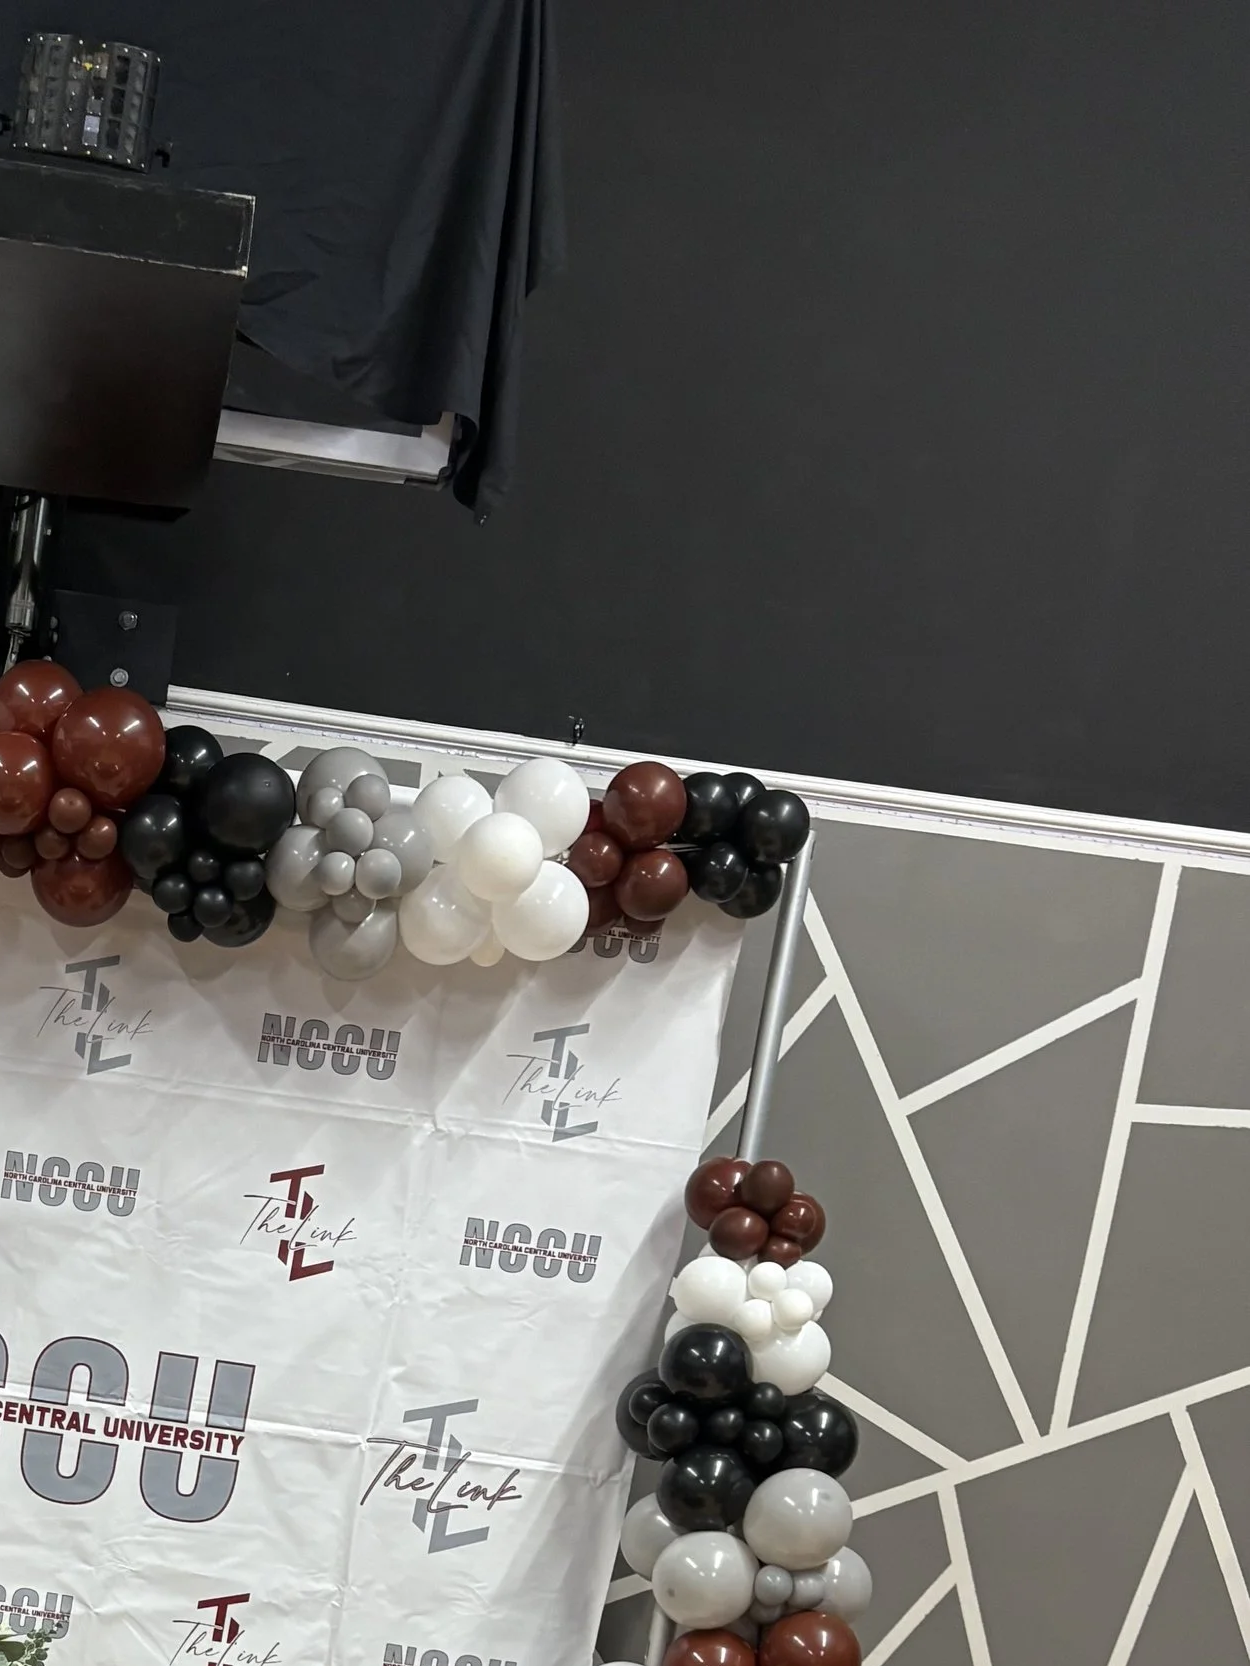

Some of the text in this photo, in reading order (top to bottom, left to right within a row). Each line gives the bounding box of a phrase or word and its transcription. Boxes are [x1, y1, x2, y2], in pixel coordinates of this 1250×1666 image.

[257, 1013, 401, 1080] NCCU
[261, 1035, 397, 1059] NORTH CAROLINA CENTRAL UNIVERSITY
[0, 1150, 141, 1217] NCCU
[4, 1172, 137, 1197] NORTH CAROLINA CENTRAL UNIVERSITY
[459, 1217, 602, 1283] NCCU
[464, 1239, 597, 1263] NORTH CAROLINA CENTRAL UNIVERSITY
[103, 1416, 244, 1456] UNIVERSITY
[0, 1605, 30, 1615] CENTRAL
